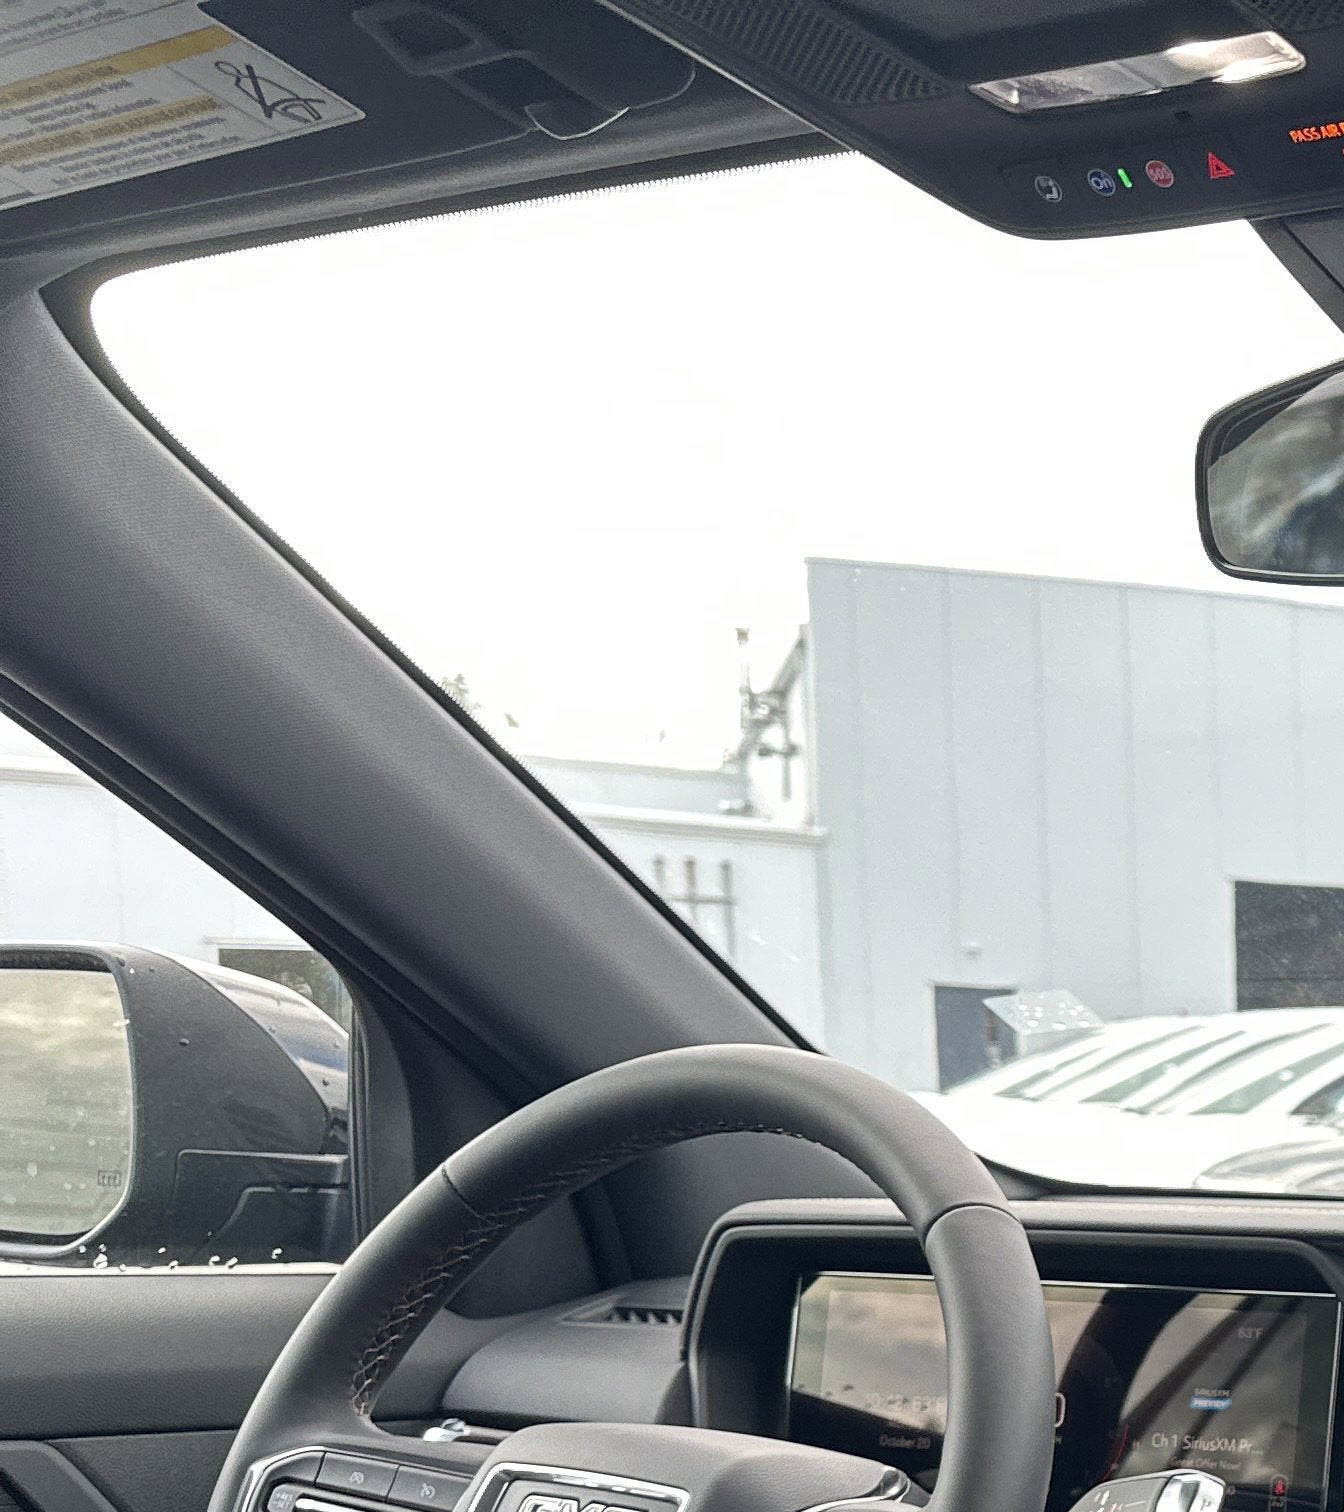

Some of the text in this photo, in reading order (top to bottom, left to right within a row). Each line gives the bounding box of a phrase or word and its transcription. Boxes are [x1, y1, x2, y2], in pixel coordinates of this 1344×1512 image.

[1288, 127, 1321, 143] PASS
[1319, 123, 1342, 139] AIR
[1151, 1433, 1168, 1448] Ch
[1170, 1434, 1179, 1448] 1
[1183, 1433, 1236, 1452] SiriusXM
